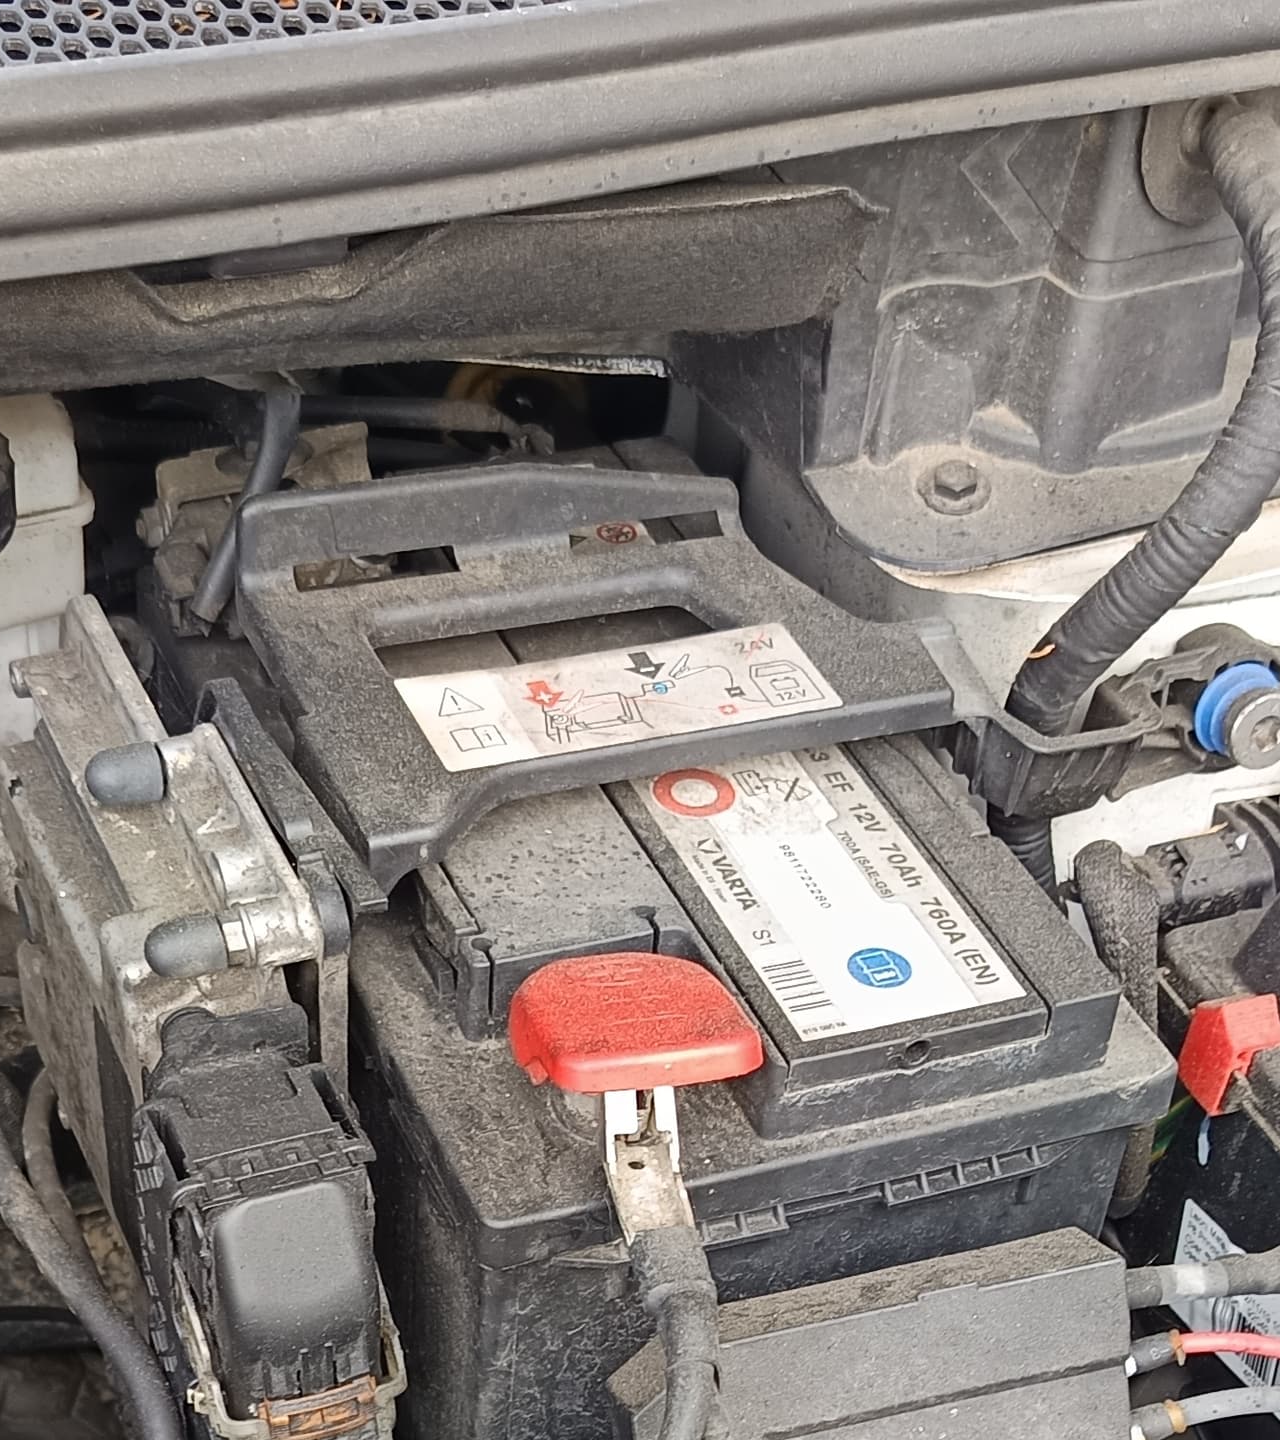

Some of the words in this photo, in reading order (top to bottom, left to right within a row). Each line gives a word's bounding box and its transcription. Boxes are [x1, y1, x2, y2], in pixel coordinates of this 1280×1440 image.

[776, 690, 807, 701] 12V
[837, 830, 861, 855] 700A
[712, 856, 757, 911] VARTA
[752, 929, 776, 946] S1
[824, 771, 854, 793] EF
[849, 803, 886, 833] 12V
[879, 843, 923, 888] 70Ah
[920, 896, 966, 944] 760A
[954, 949, 1000, 985] (EN)
